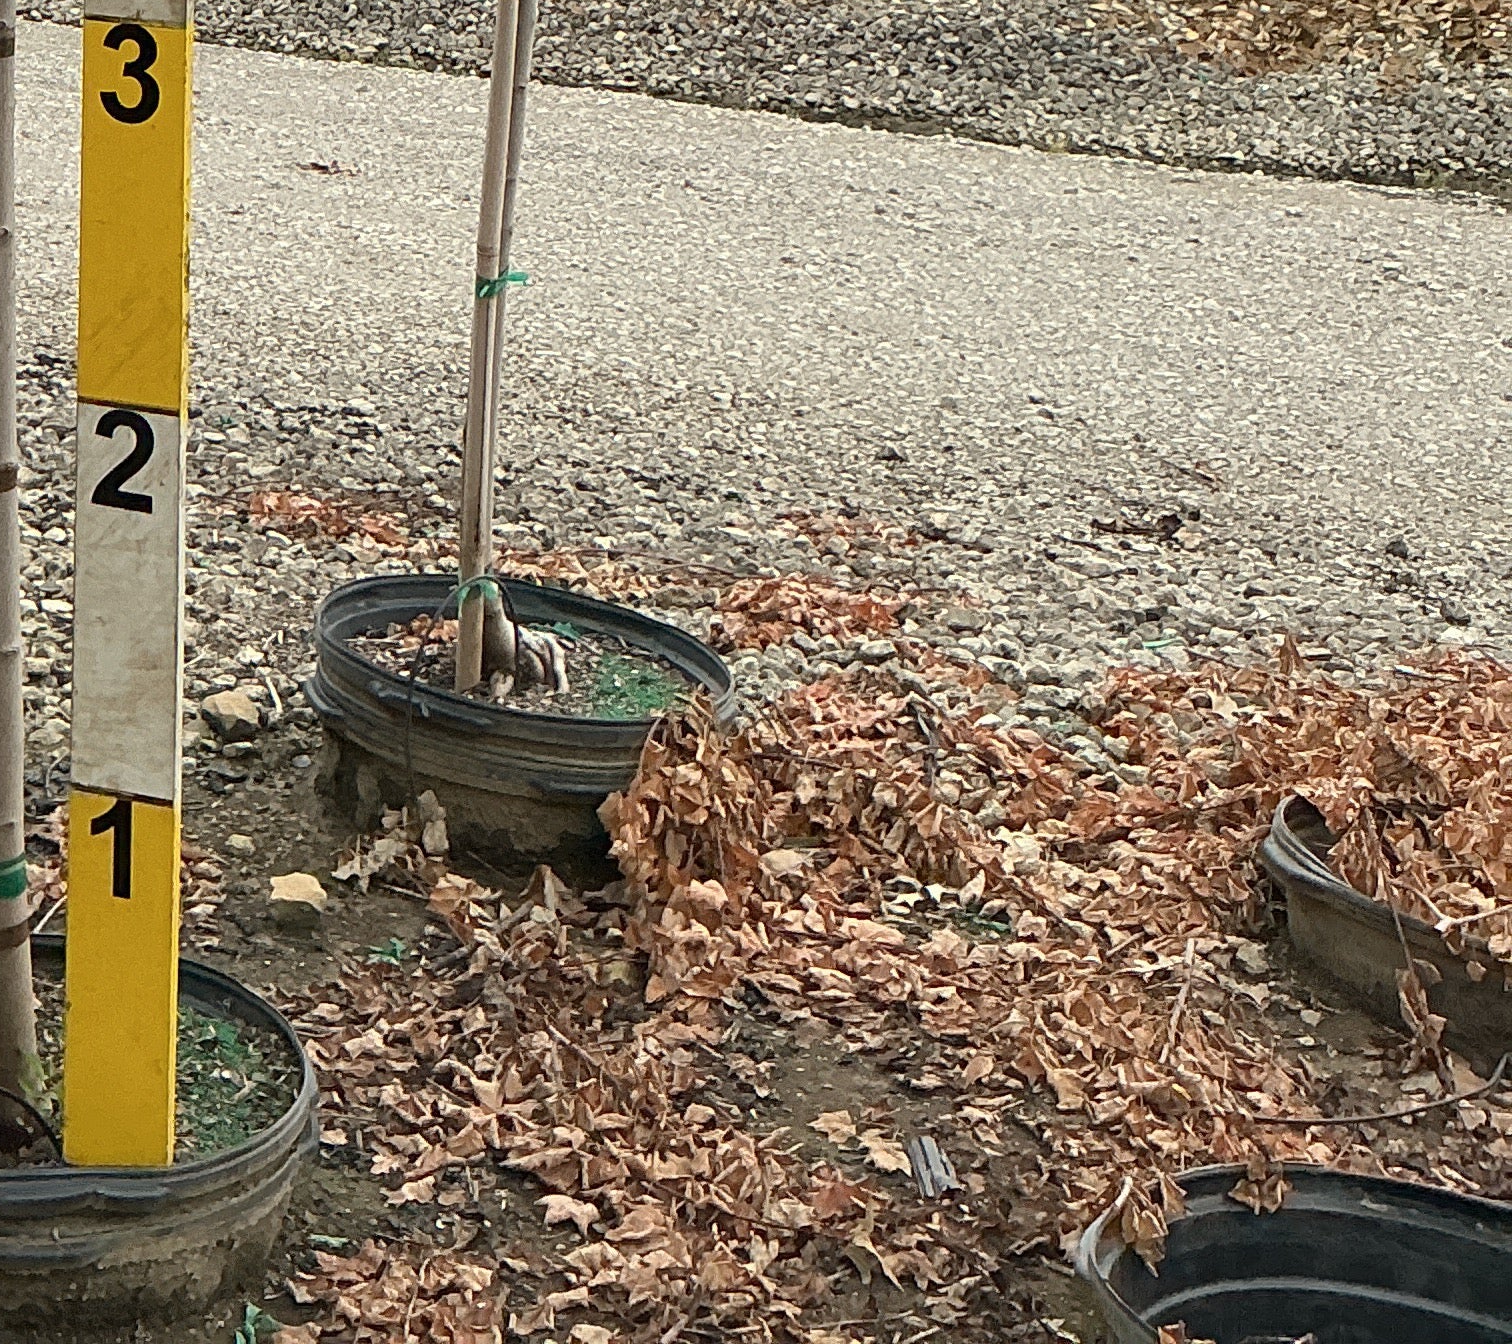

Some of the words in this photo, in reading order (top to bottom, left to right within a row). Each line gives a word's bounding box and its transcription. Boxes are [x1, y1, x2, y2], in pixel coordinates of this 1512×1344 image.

[100, 23, 161, 125] 3
[90, 409, 157, 515] 2
[90, 799, 134, 900] 1
